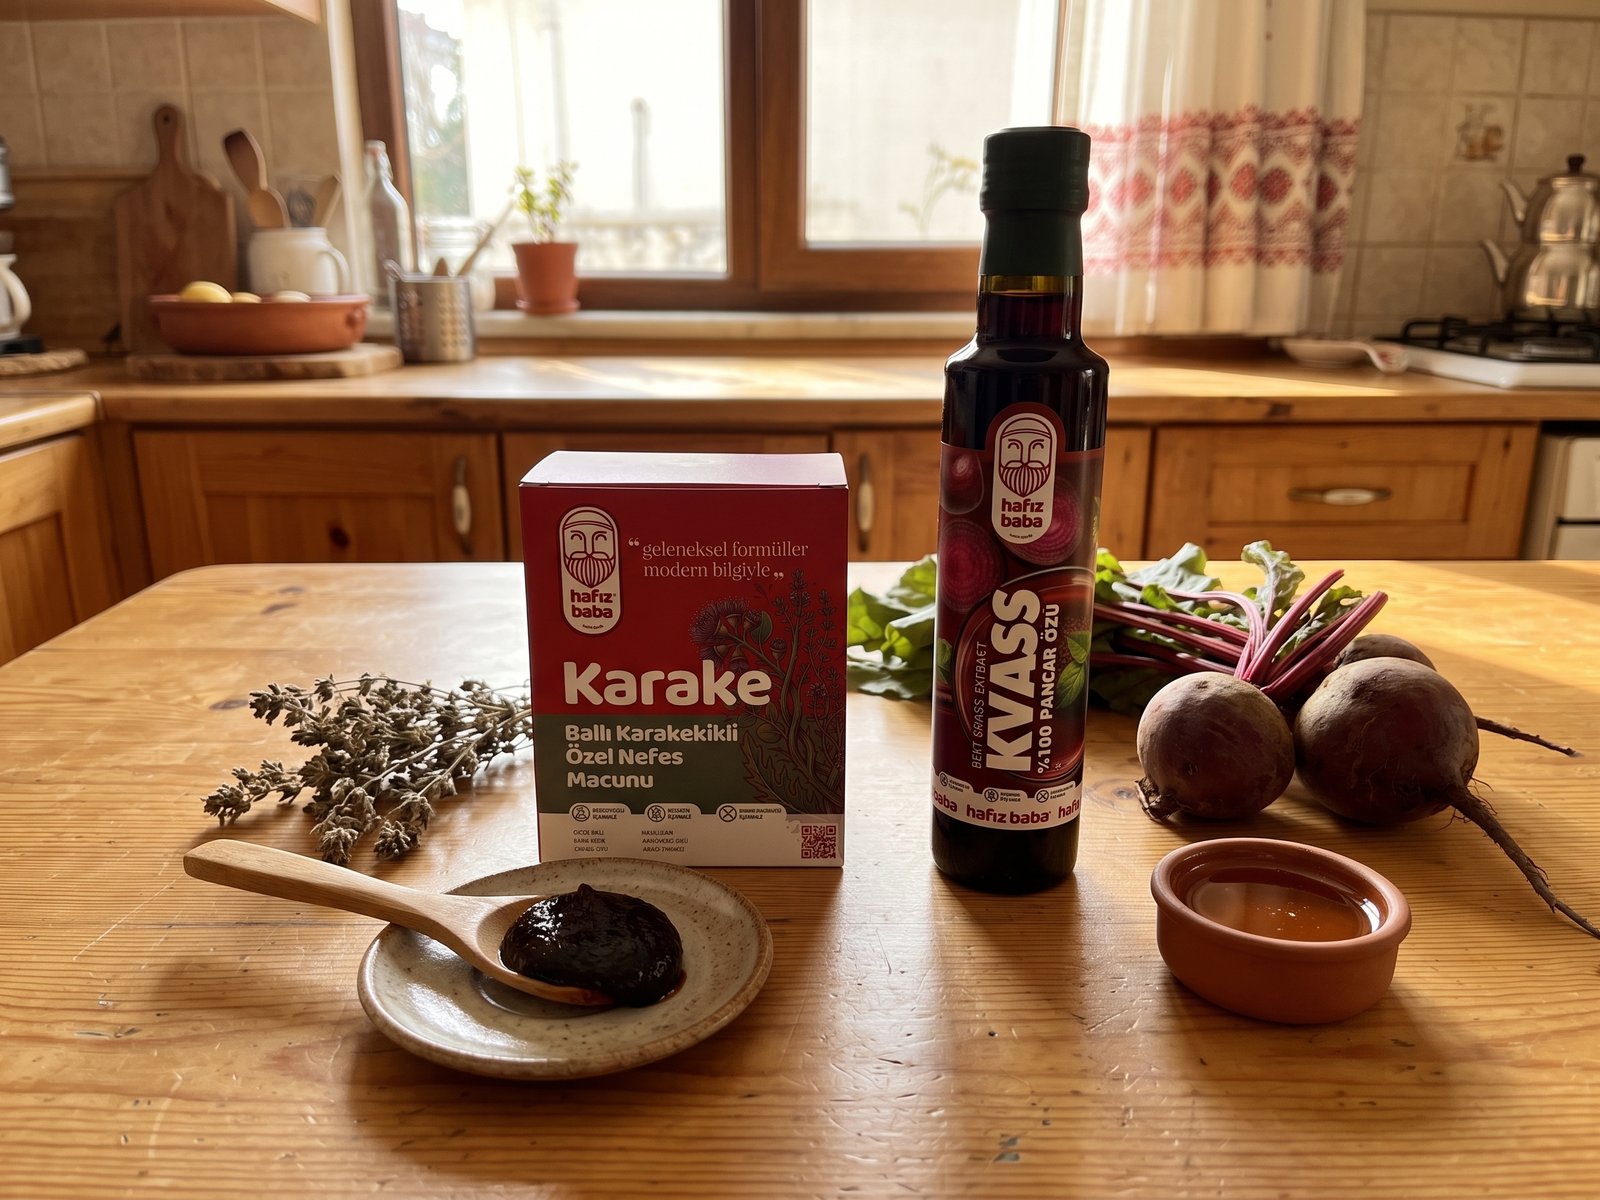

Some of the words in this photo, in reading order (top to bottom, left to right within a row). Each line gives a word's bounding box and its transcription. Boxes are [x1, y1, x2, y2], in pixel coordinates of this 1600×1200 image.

[1000, 513, 1043, 528] baba
[732, 540, 809, 558] formüller
[643, 561, 708, 578] modern
[571, 604, 614, 619] baba
[563, 659, 772, 706] Karake
[986, 589, 1041, 772] KVASS
[1040, 647, 1058, 721] PANCAR
[564, 723, 612, 742] Ballı
[616, 722, 739, 742] Karakekikli
[565, 743, 614, 765] Özel
[618, 747, 684, 765] Nefes
[1037, 725, 1053, 775] %100
[567, 771, 654, 788] Macunu
[1009, 810, 1050, 825] baba
